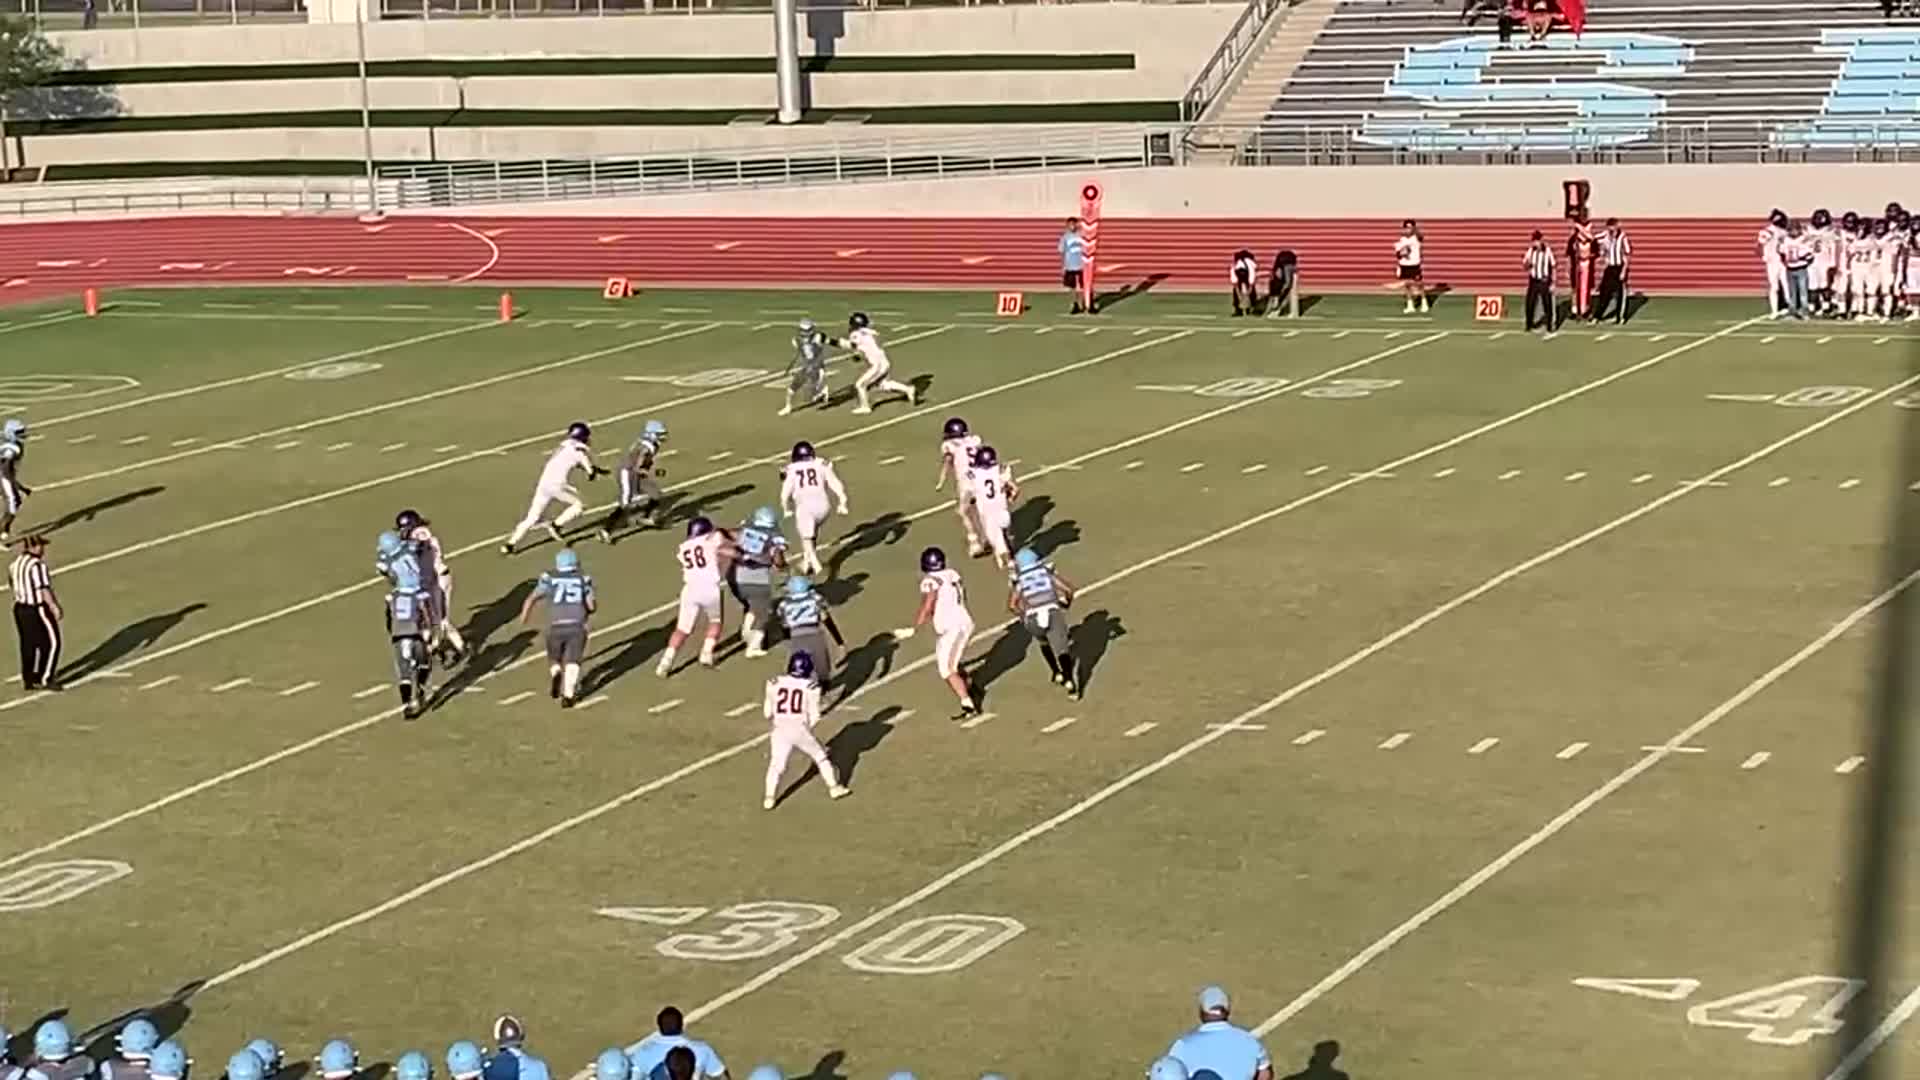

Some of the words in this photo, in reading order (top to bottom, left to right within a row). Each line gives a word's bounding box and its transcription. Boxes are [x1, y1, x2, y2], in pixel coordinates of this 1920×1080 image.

[609, 281, 622, 295] G
[1002, 297, 1018, 312] 10
[1480, 300, 1499, 317] 20
[796, 468, 819, 488] 78
[985, 479, 996, 499] 3
[683, 544, 707, 569] 58
[551, 577, 582, 603] 75
[776, 688, 803, 714] 20
[655, 901, 1026, 974] 30
[1687, 975, 1867, 1046] 4
